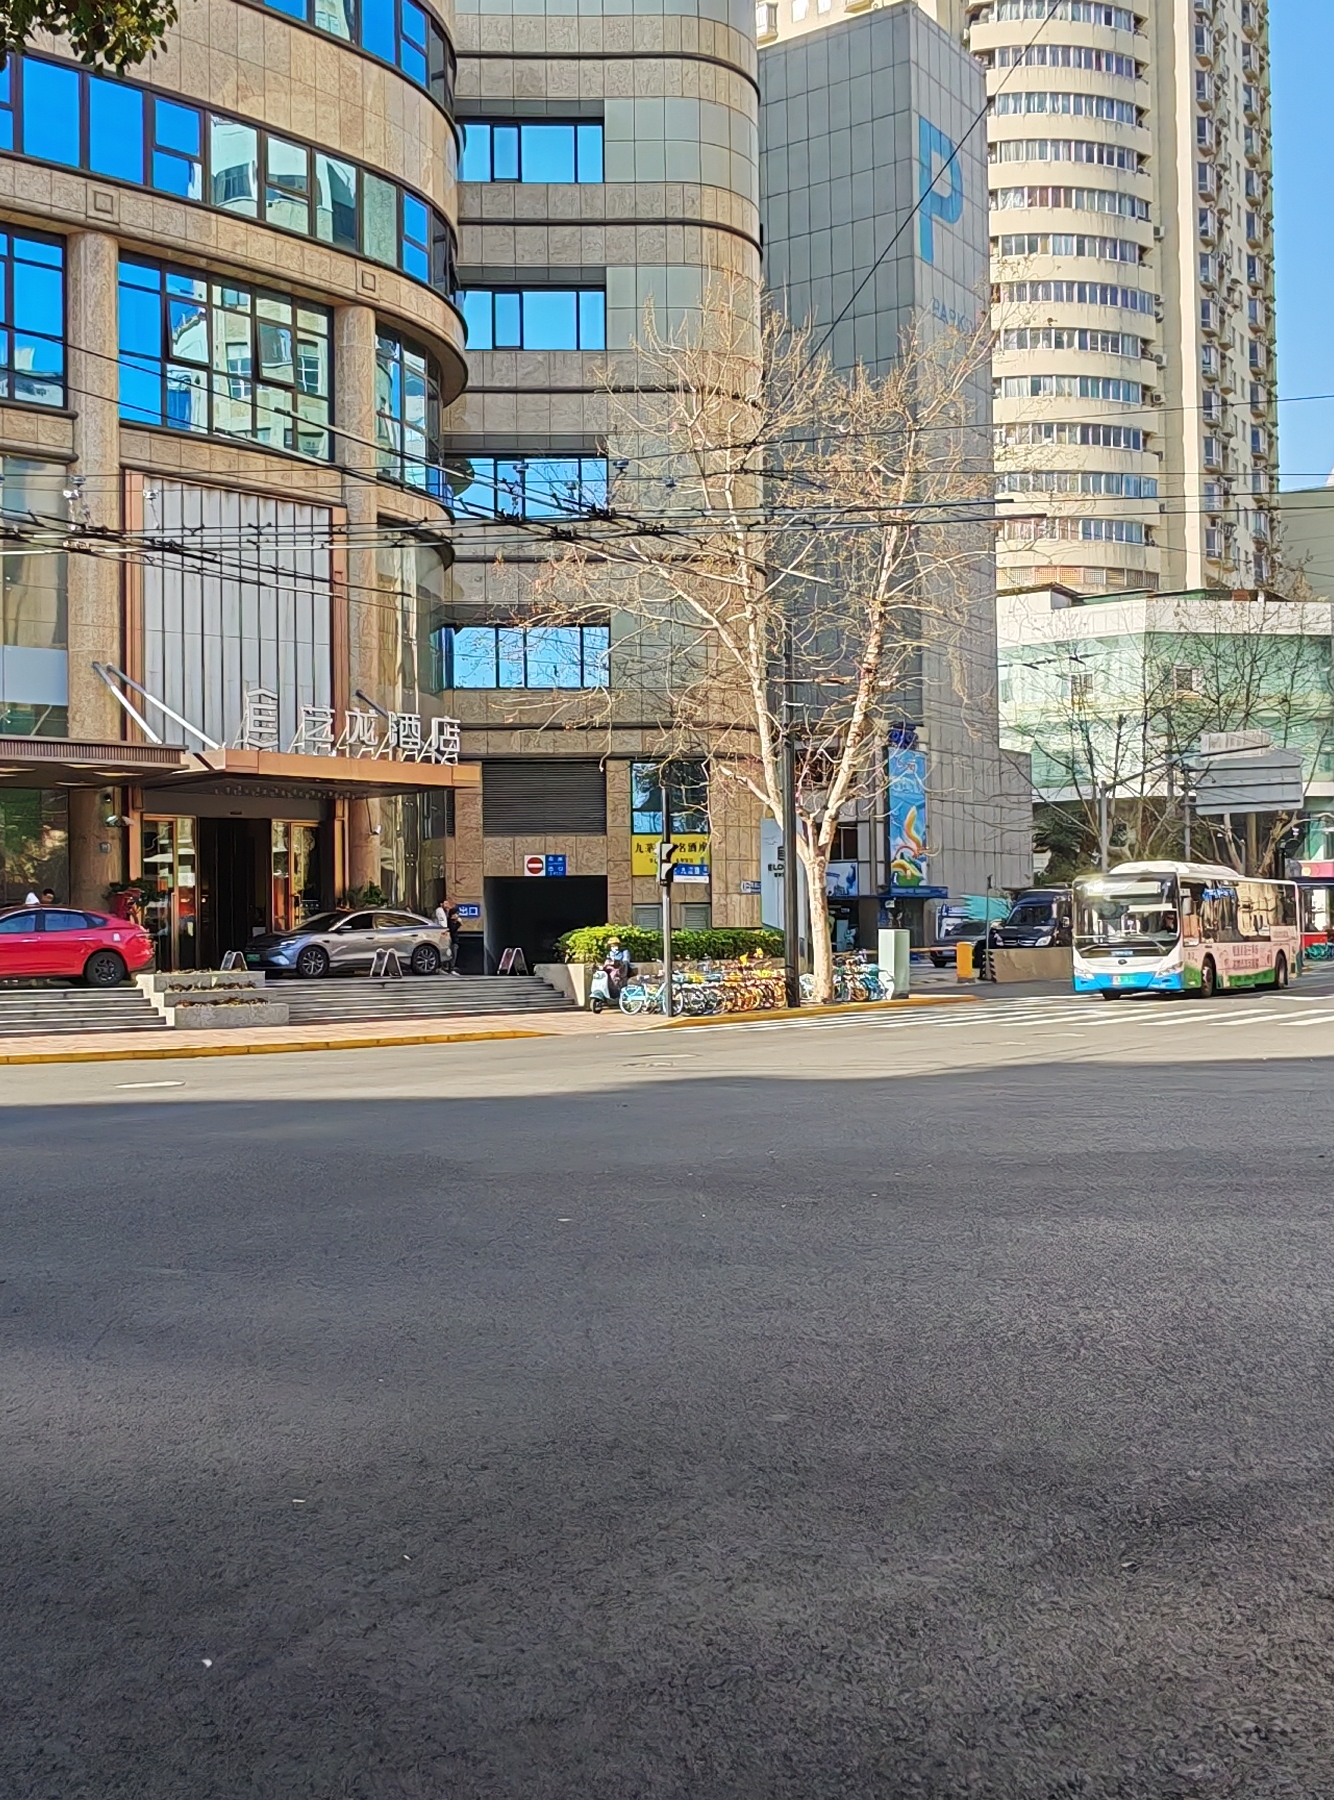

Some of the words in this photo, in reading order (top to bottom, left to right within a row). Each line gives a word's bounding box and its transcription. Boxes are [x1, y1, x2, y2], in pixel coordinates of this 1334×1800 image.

[919, 115, 963, 265] P
[301, 703, 461, 753] 艺龙酒店
[459, 906, 478, 916] 出口
